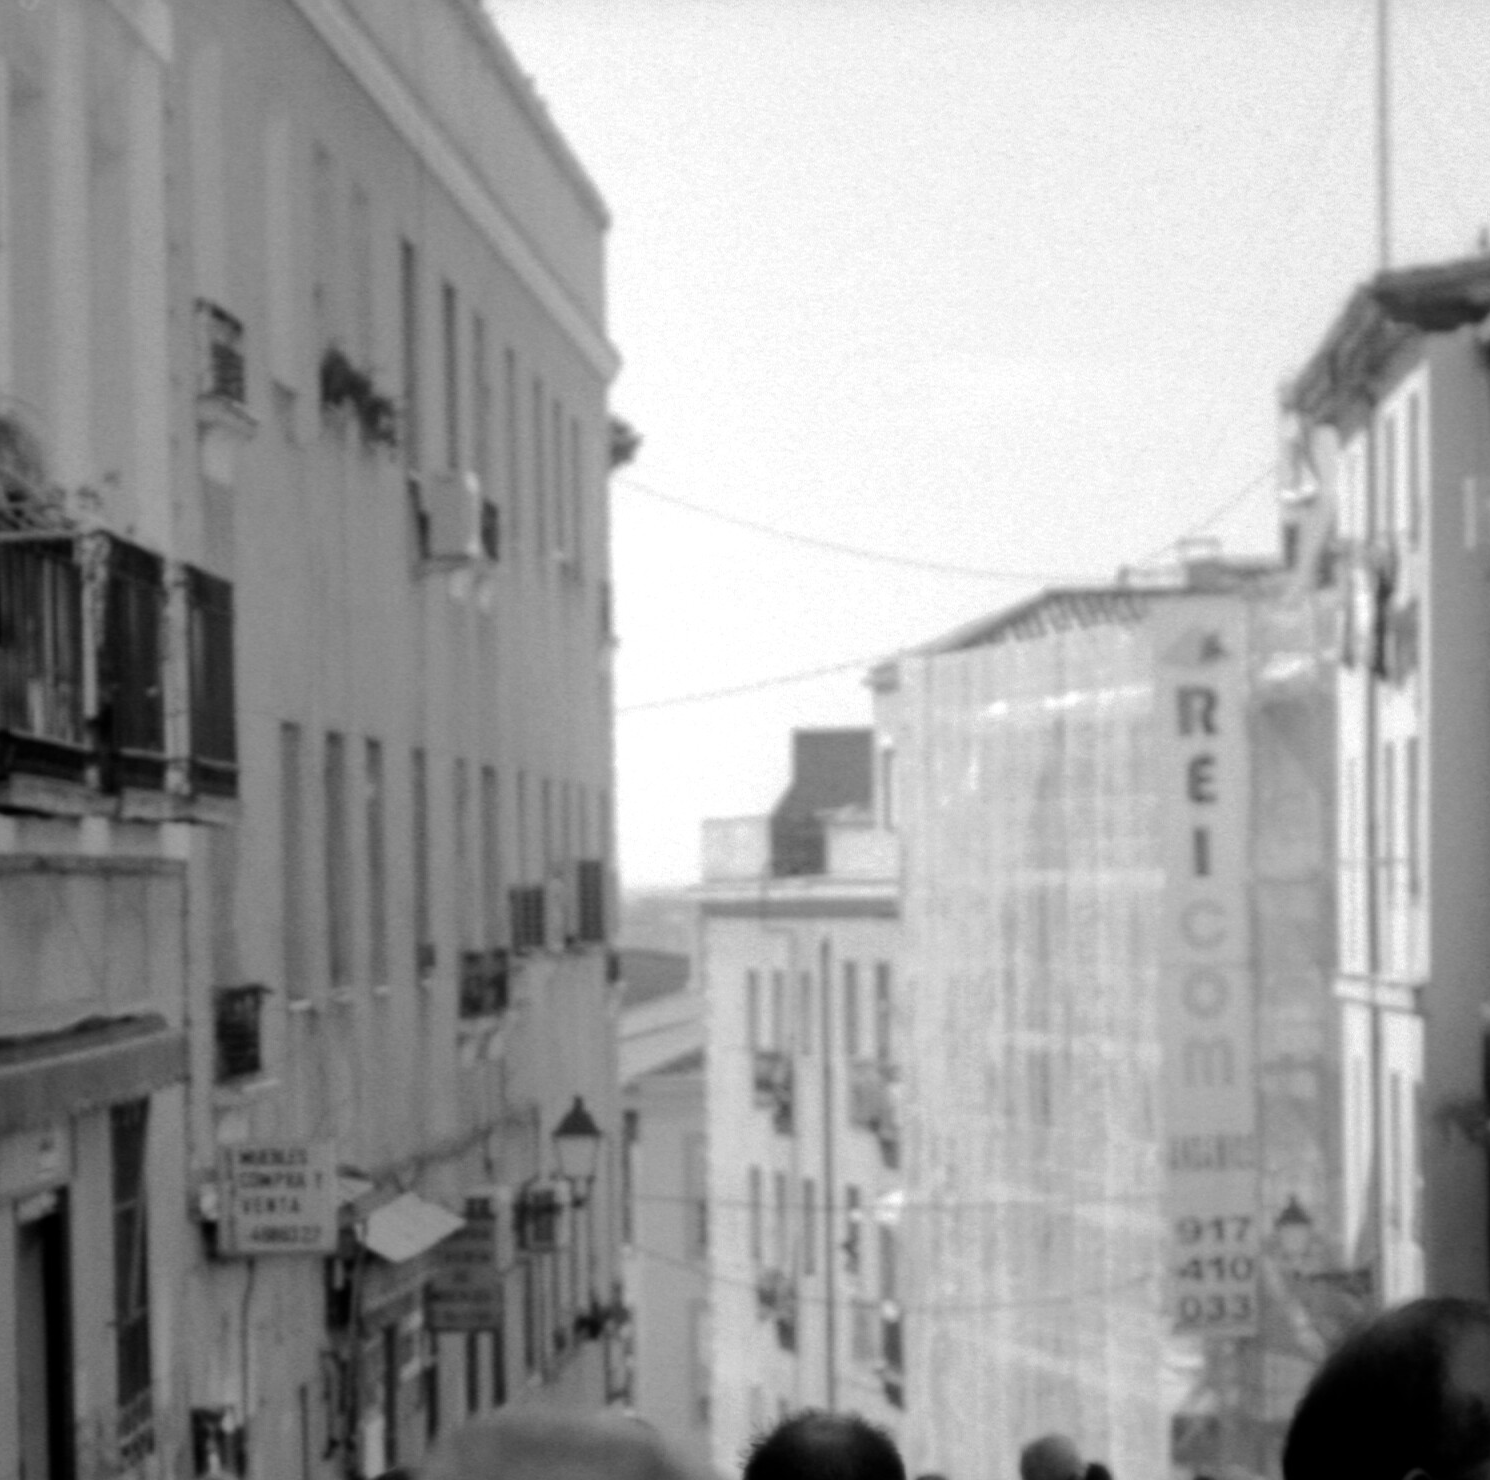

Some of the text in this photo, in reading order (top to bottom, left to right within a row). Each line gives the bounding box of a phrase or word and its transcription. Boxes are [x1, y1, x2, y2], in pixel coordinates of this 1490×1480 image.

[238, 1170, 306, 1188] COMPRA
[242, 1196, 301, 1215] VENTA
[1175, 1215, 1251, 1244] 917
[1174, 1256, 1254, 1282] 410
[1178, 1294, 1252, 1323] 033
